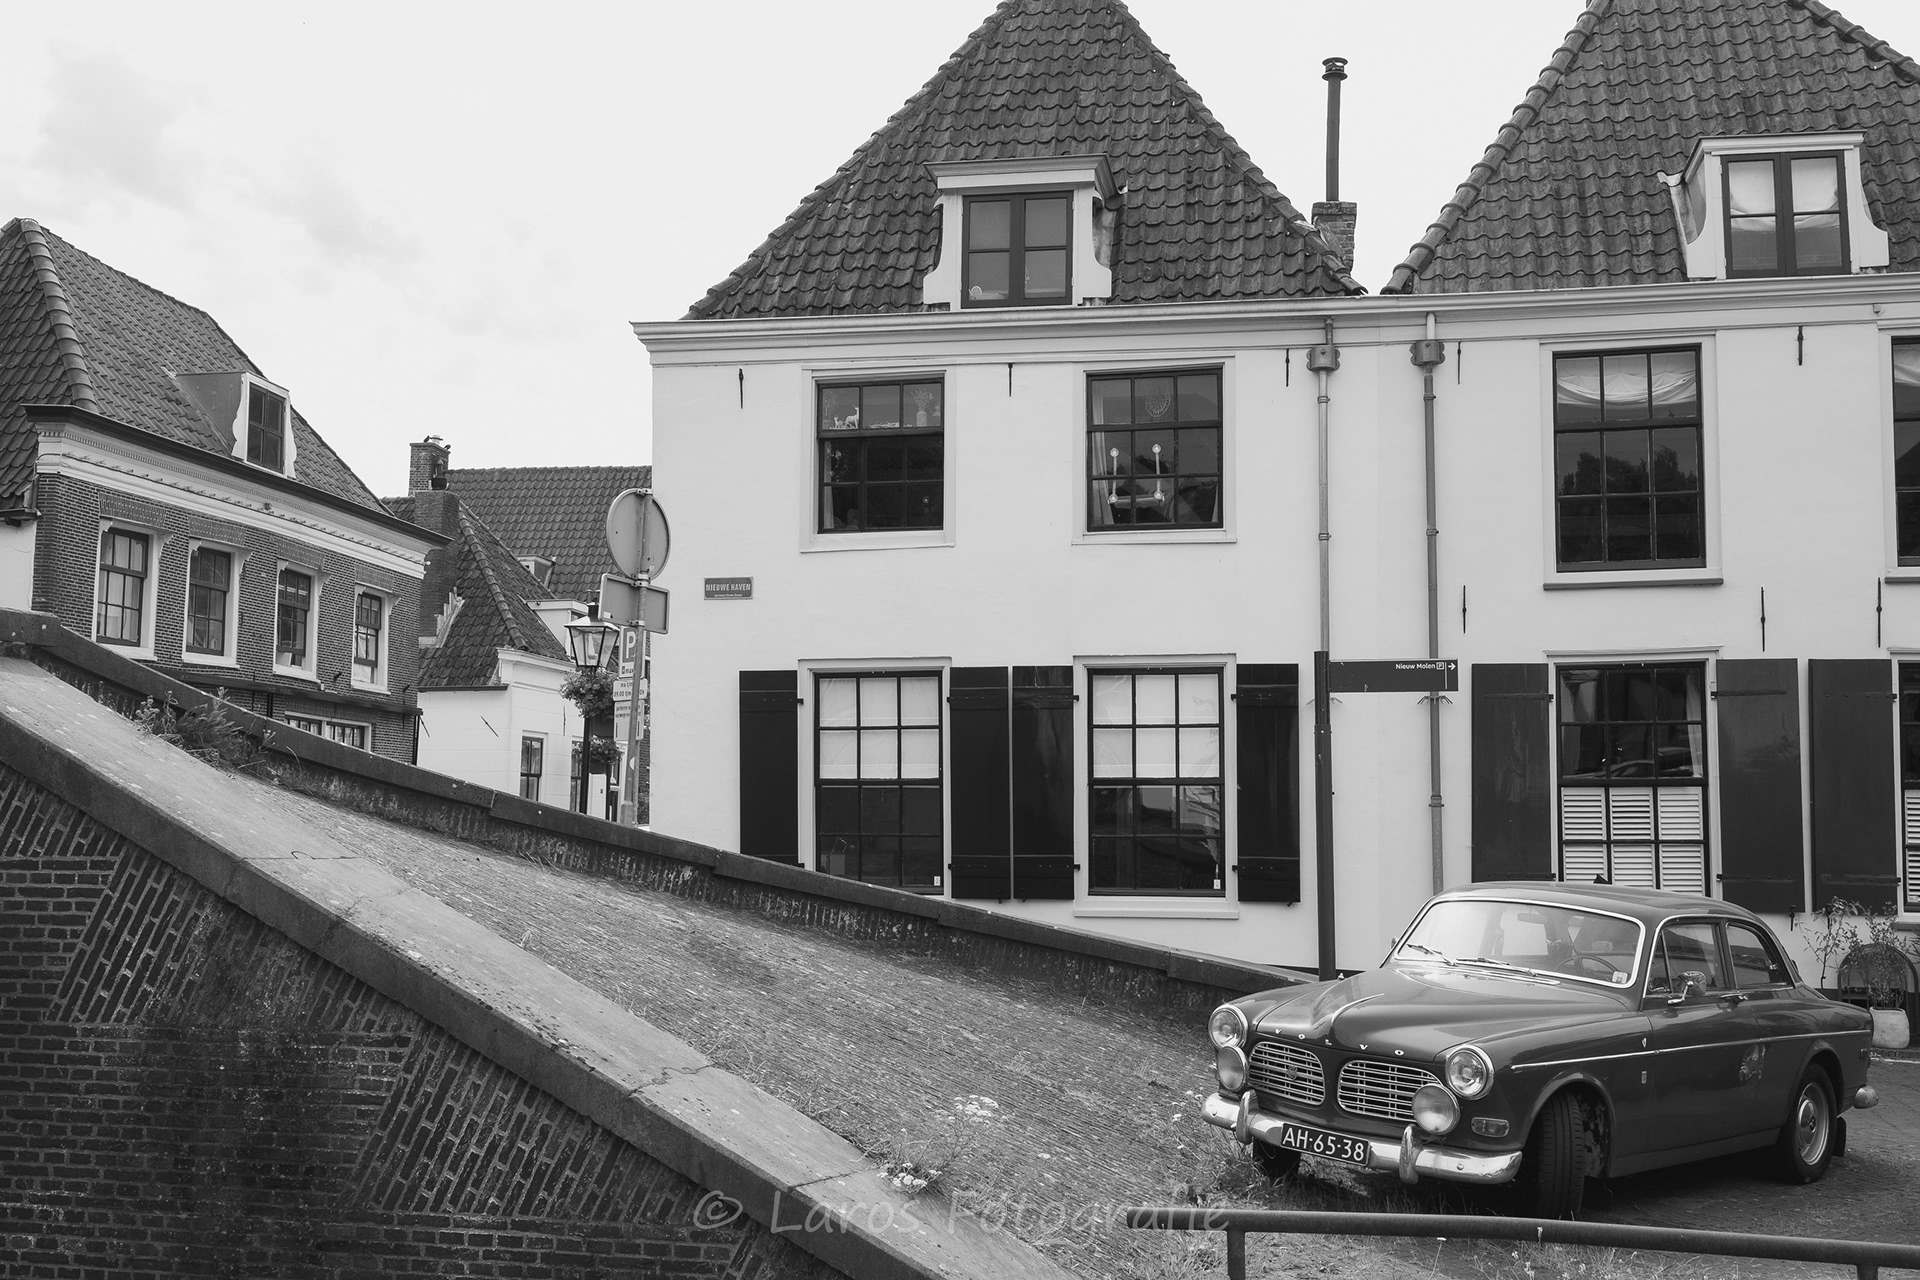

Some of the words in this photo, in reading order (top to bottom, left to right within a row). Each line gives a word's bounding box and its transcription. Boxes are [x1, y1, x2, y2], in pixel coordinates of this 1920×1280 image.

[705, 583, 730, 591] NIEUWE
[730, 583, 751, 591] HAVEN
[626, 631, 636, 659] P
[1416, 662, 1436, 670] Molen
[1275, 1028, 1405, 1056] VOLVO
[1282, 1127, 1364, 1161] AH-65-38
